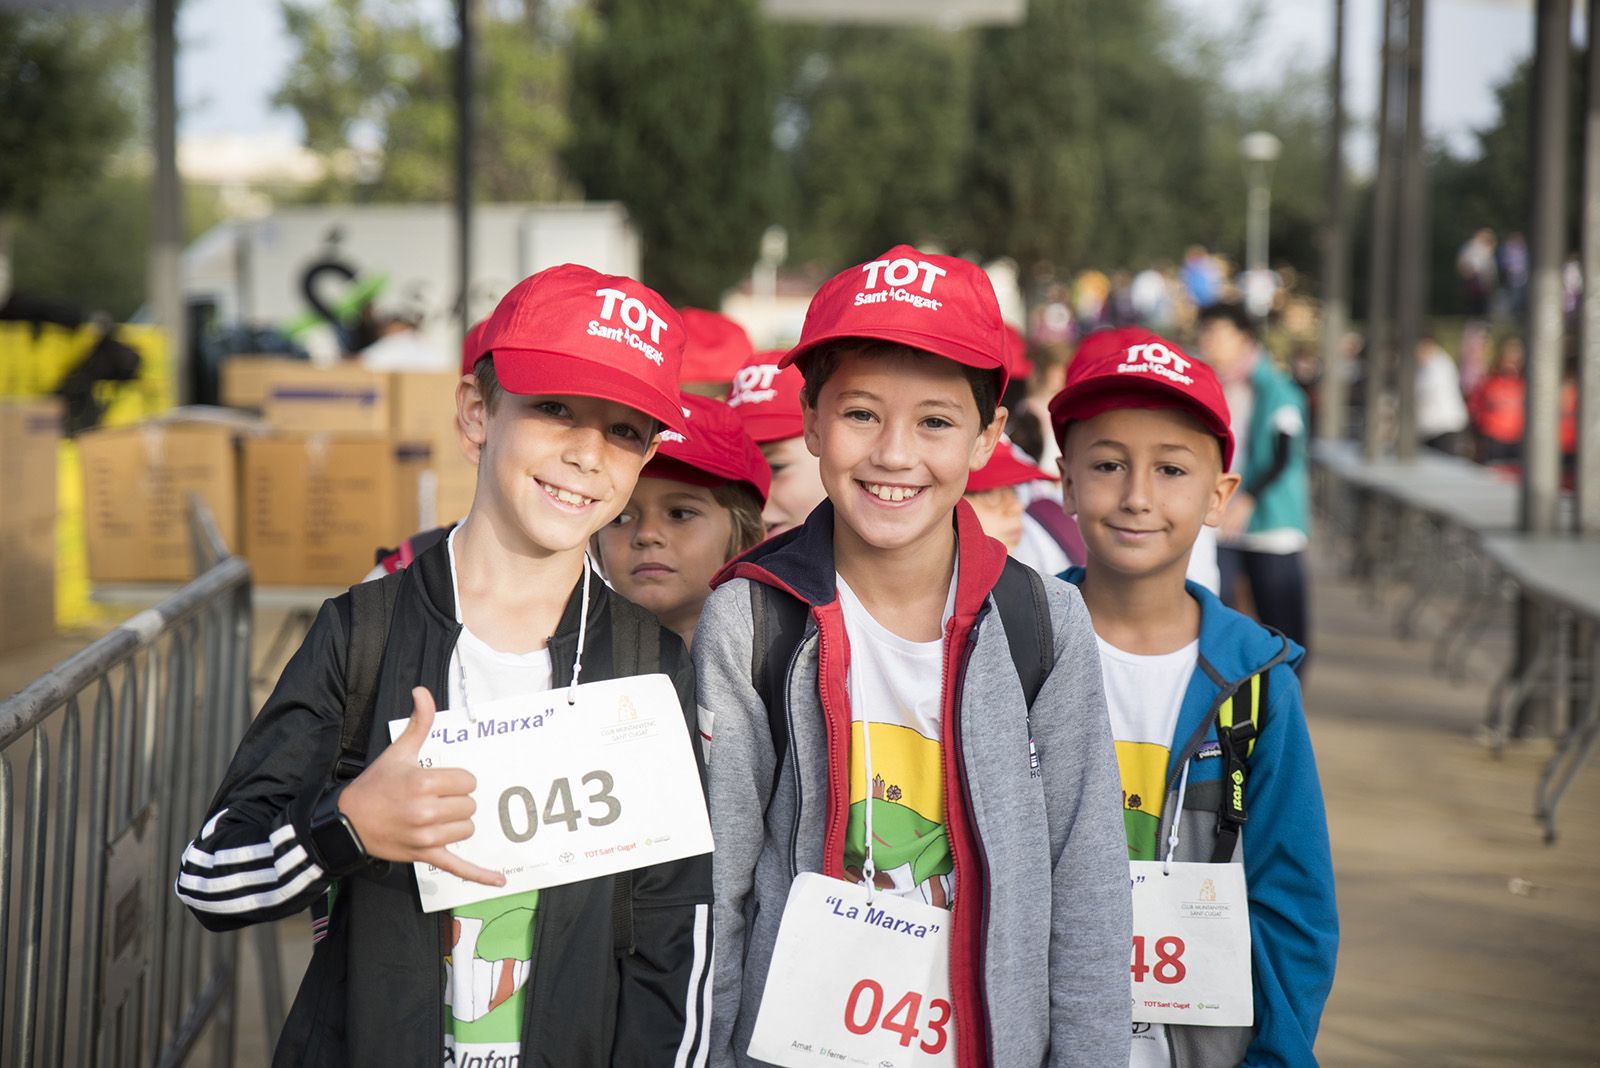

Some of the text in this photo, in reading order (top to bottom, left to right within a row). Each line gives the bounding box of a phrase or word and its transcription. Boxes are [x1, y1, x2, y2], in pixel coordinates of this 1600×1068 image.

[862, 258, 947, 294] TOT
[854, 288, 943, 311] Sant Cugat
[596, 288, 668, 345] TOT
[586, 320, 664, 367] Sant Cugat
[1126, 343, 1192, 374] TOT
[1117, 362, 1148, 373] Sant
[497, 769, 622, 843] 043
[584, 842, 637, 859] TOT Sant Cugat
[844, 978, 952, 1055] 043
[791, 1040, 813, 1052] Amat
